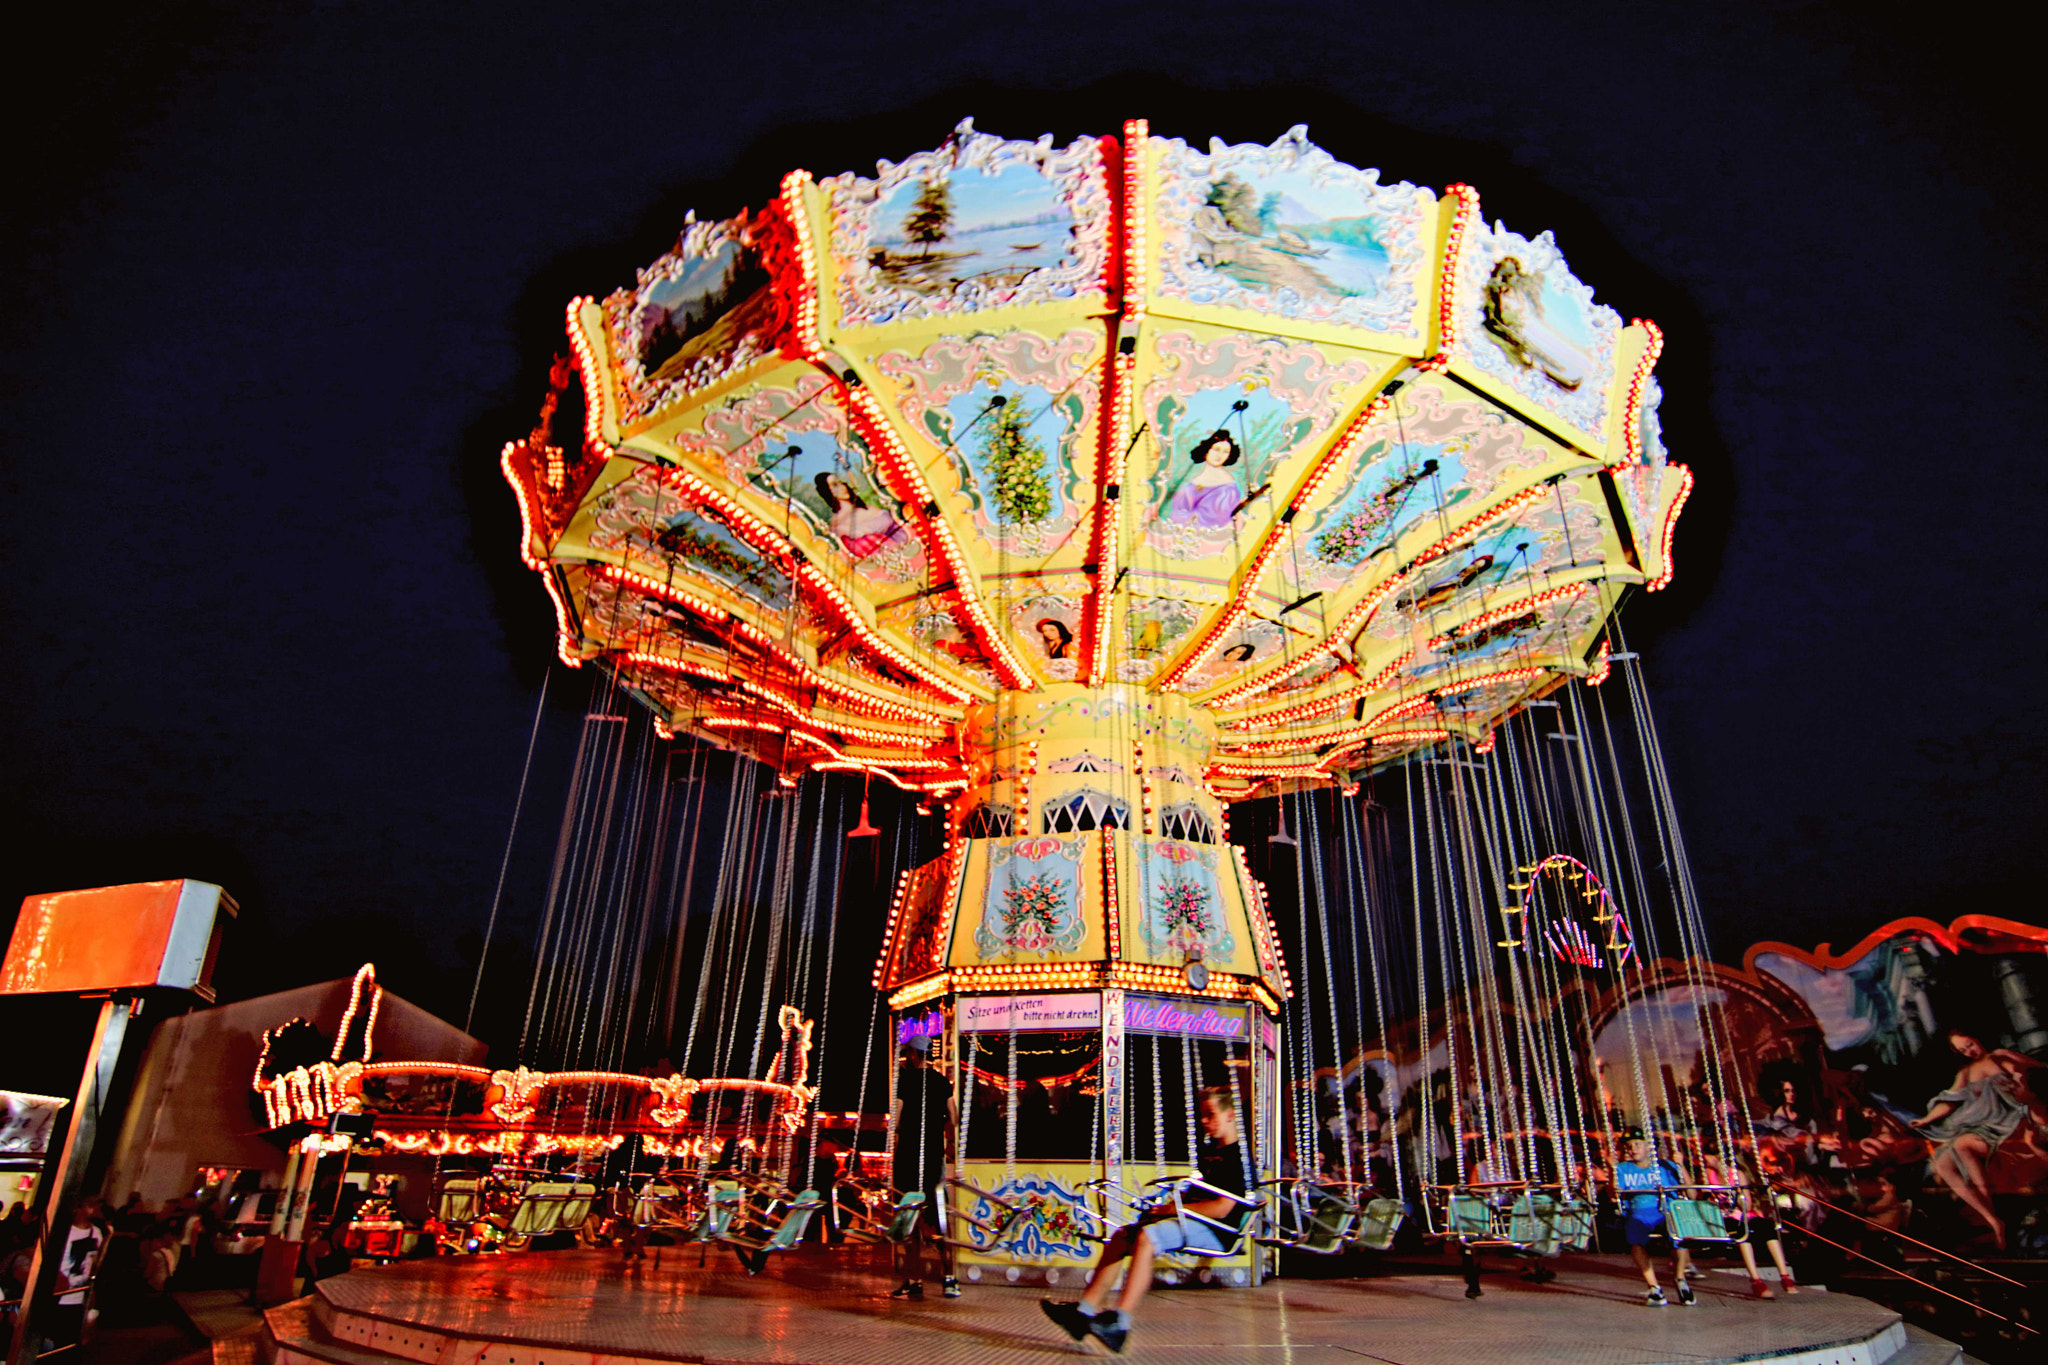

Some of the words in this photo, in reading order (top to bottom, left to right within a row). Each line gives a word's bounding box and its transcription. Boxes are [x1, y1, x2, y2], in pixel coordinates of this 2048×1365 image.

[967, 1006, 992, 1019] Sitze
[993, 1004, 1012, 1014] und
[1014, 999, 1043, 1012] Ketten
[1023, 1011, 1041, 1021] bitte
[1043, 1010, 1065, 1021] nicht
[1124, 1000, 1243, 1036] Wellenflug
